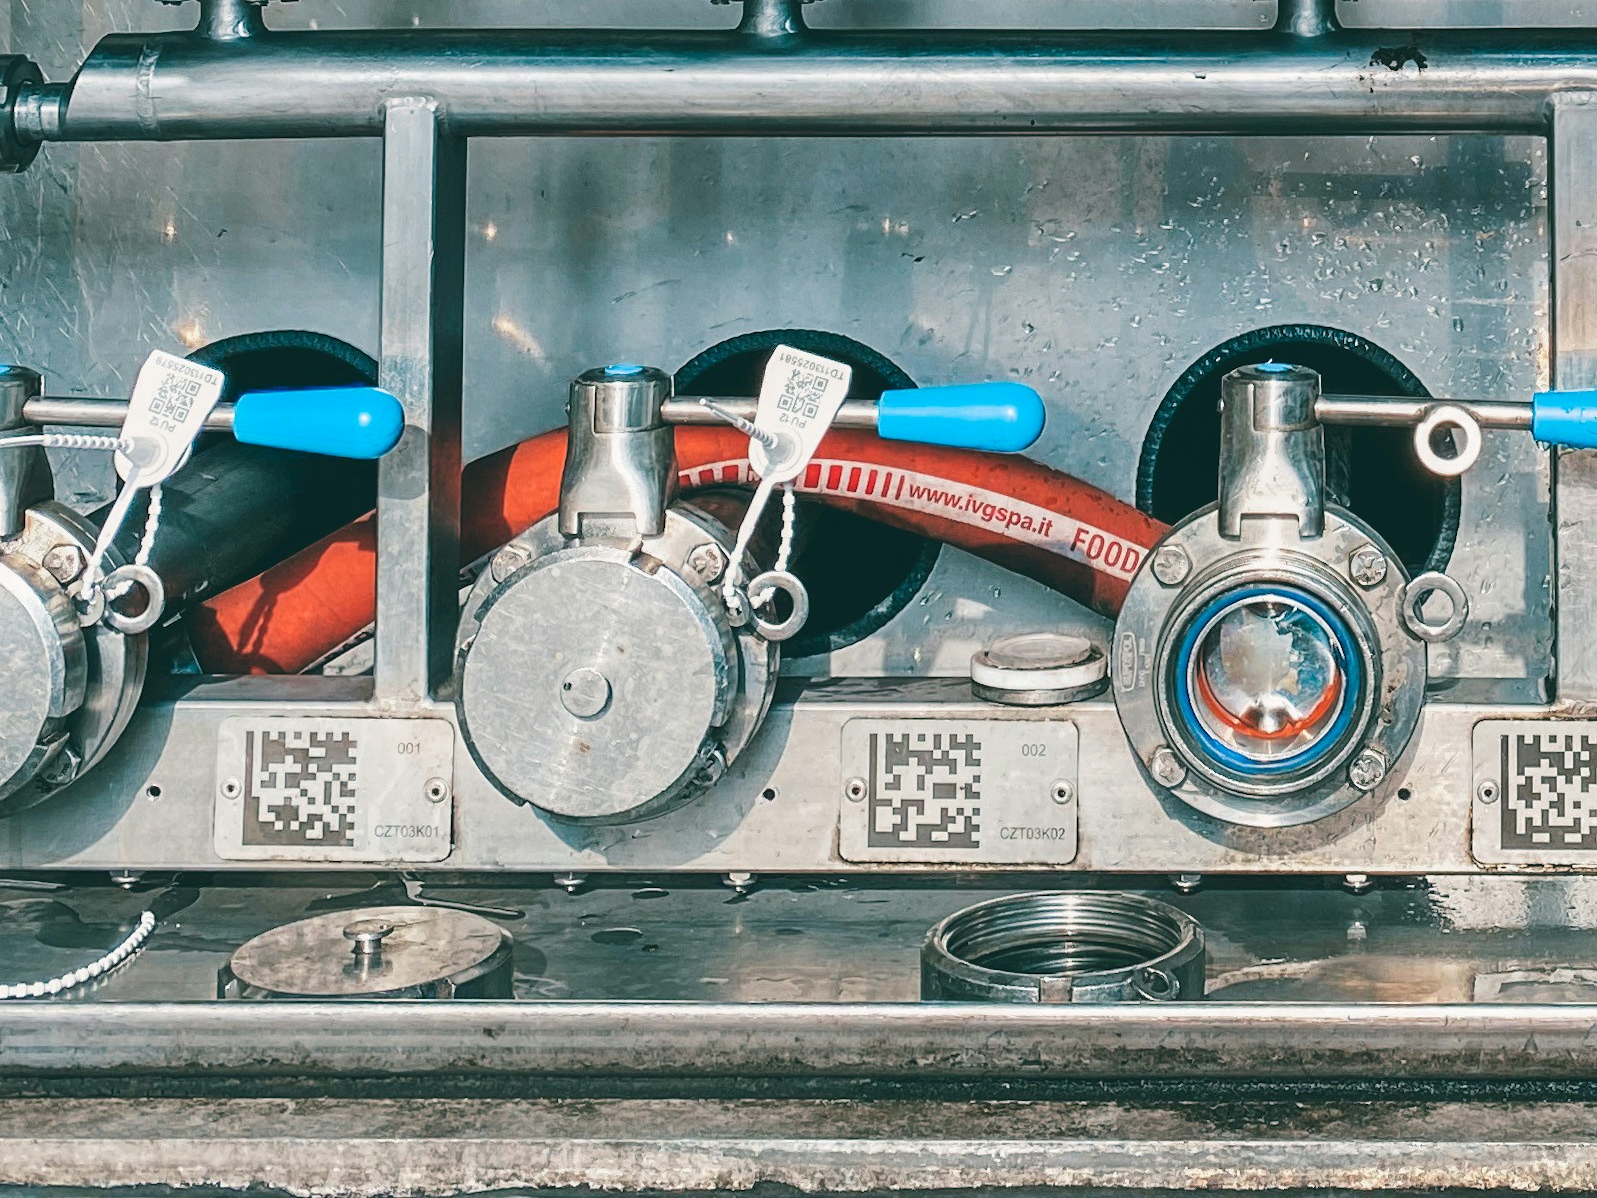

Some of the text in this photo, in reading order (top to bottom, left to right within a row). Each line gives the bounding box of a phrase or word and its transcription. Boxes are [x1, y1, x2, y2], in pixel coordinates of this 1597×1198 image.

[149, 415, 176, 433] PU 12
[779, 412, 808, 429] PU 12
[908, 482, 1140, 574] www.ivgspa.it FOOD
[397, 743, 421, 755] 001
[1021, 744, 1046, 756] 002
[374, 825, 439, 838] CZT03K01
[1000, 827, 1065, 840] CZT03K02
